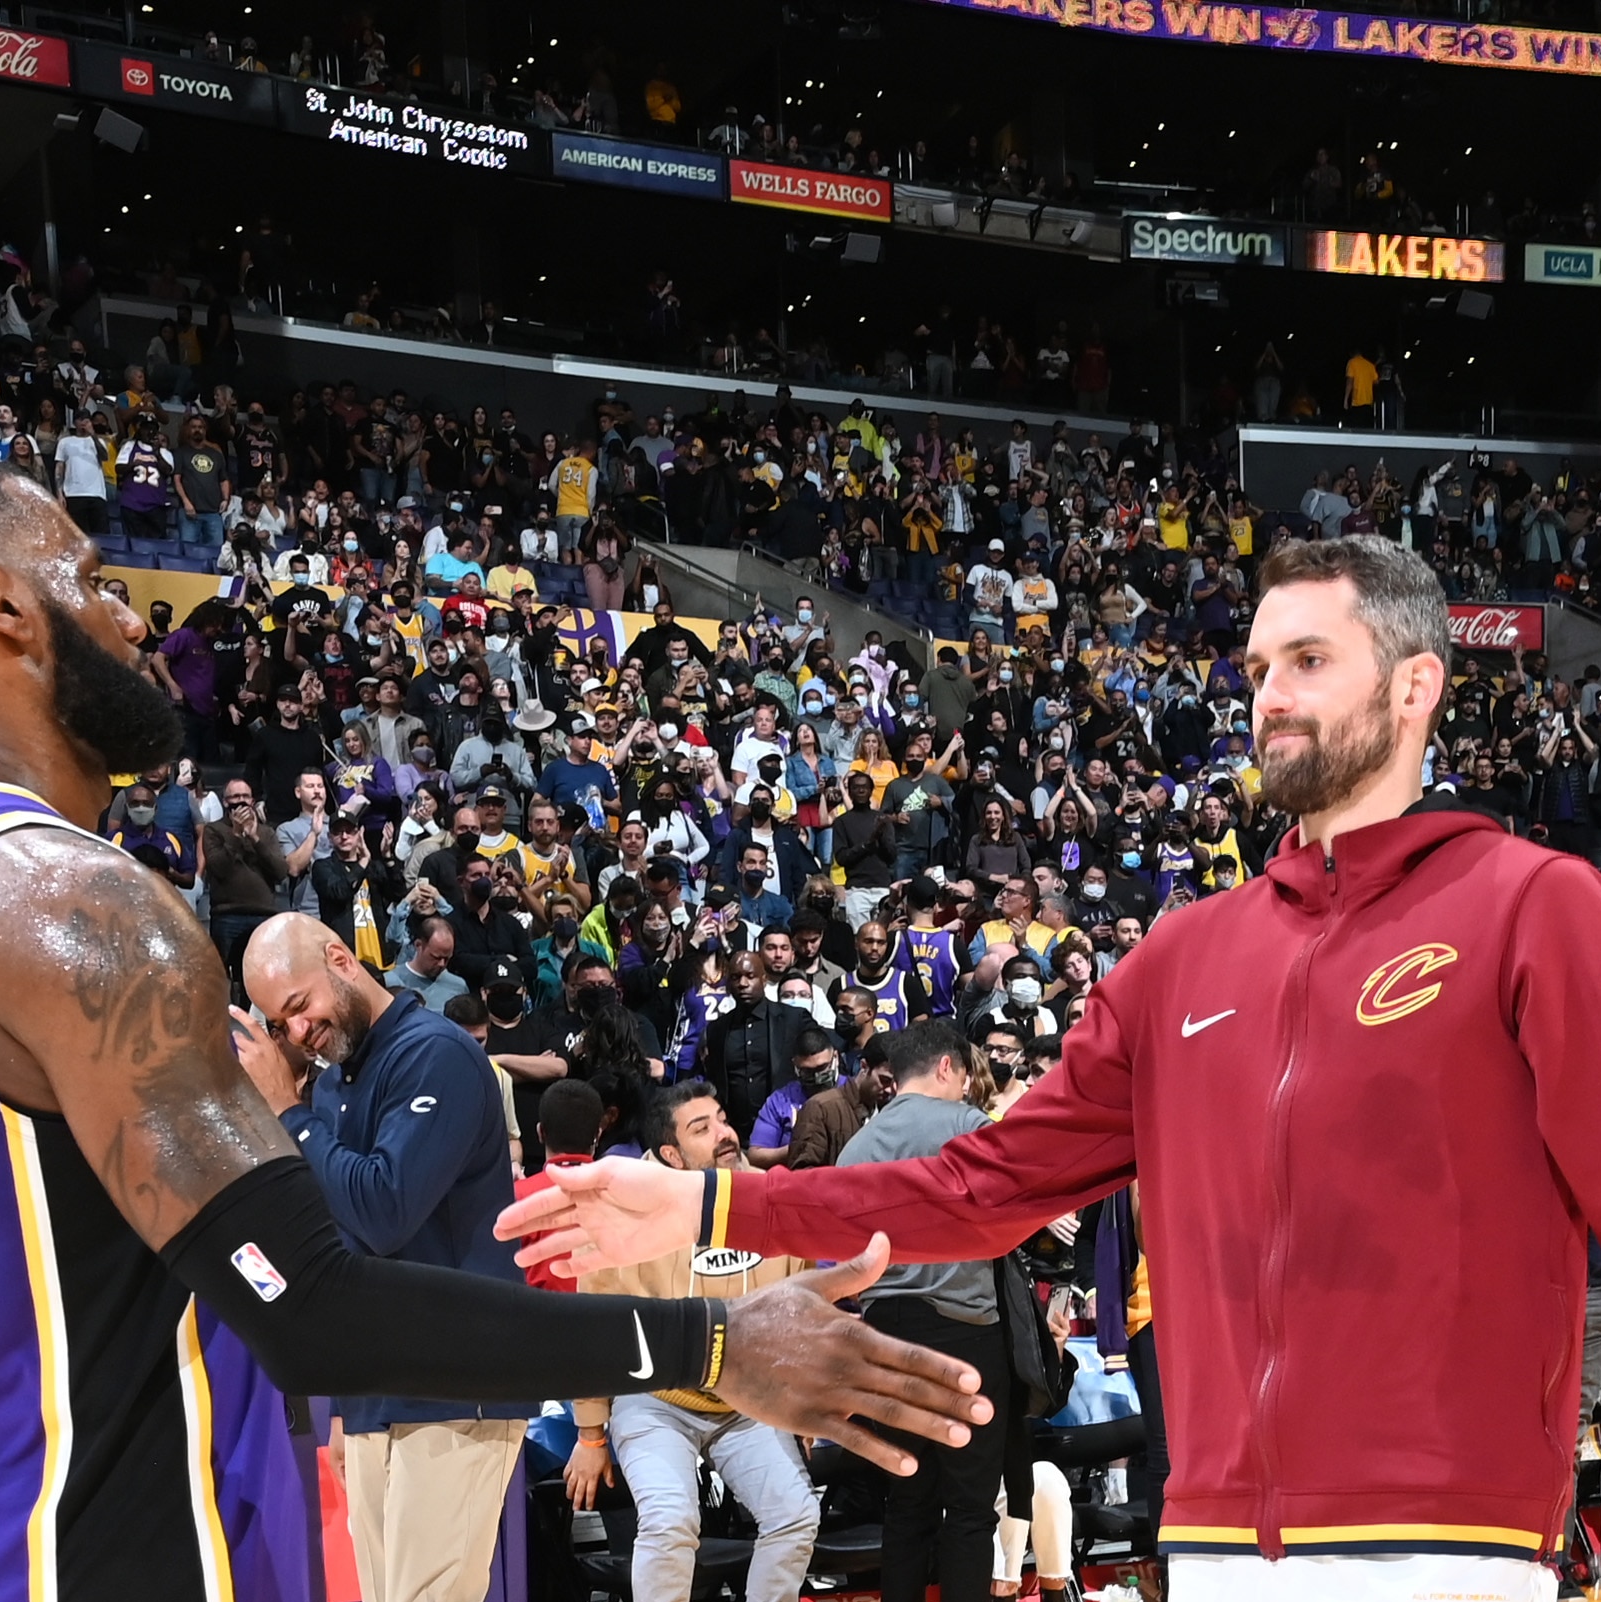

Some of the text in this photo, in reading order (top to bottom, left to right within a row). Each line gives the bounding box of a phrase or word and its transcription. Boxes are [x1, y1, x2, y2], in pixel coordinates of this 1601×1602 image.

[972, 0, 1260, 44] KERS WIN
[1333, 17, 1514, 63] LAKERS
[160, 74, 234, 102] TOYOTA
[305, 88, 528, 149] St. John Chrysostom
[329, 119, 508, 171] American Coptic
[561, 147, 717, 184] AMERICAN EXPRESS
[740, 170, 882, 208] WELLS FARGO
[1133, 221, 1272, 260] Spectrum
[1326, 231, 1486, 282] LAKERS
[1550, 255, 1589, 275] UCLA
[133, 466, 160, 486] 32
[562, 465, 584, 487] 34
[292, 600, 321, 613] DAVIS
[1116, 741, 1141, 760] 24
[704, 1333, 725, 1391] PROMISE
[1413, 1593, 1427, 1601] ALL
[1430, 1593, 1446, 1601] FOR
